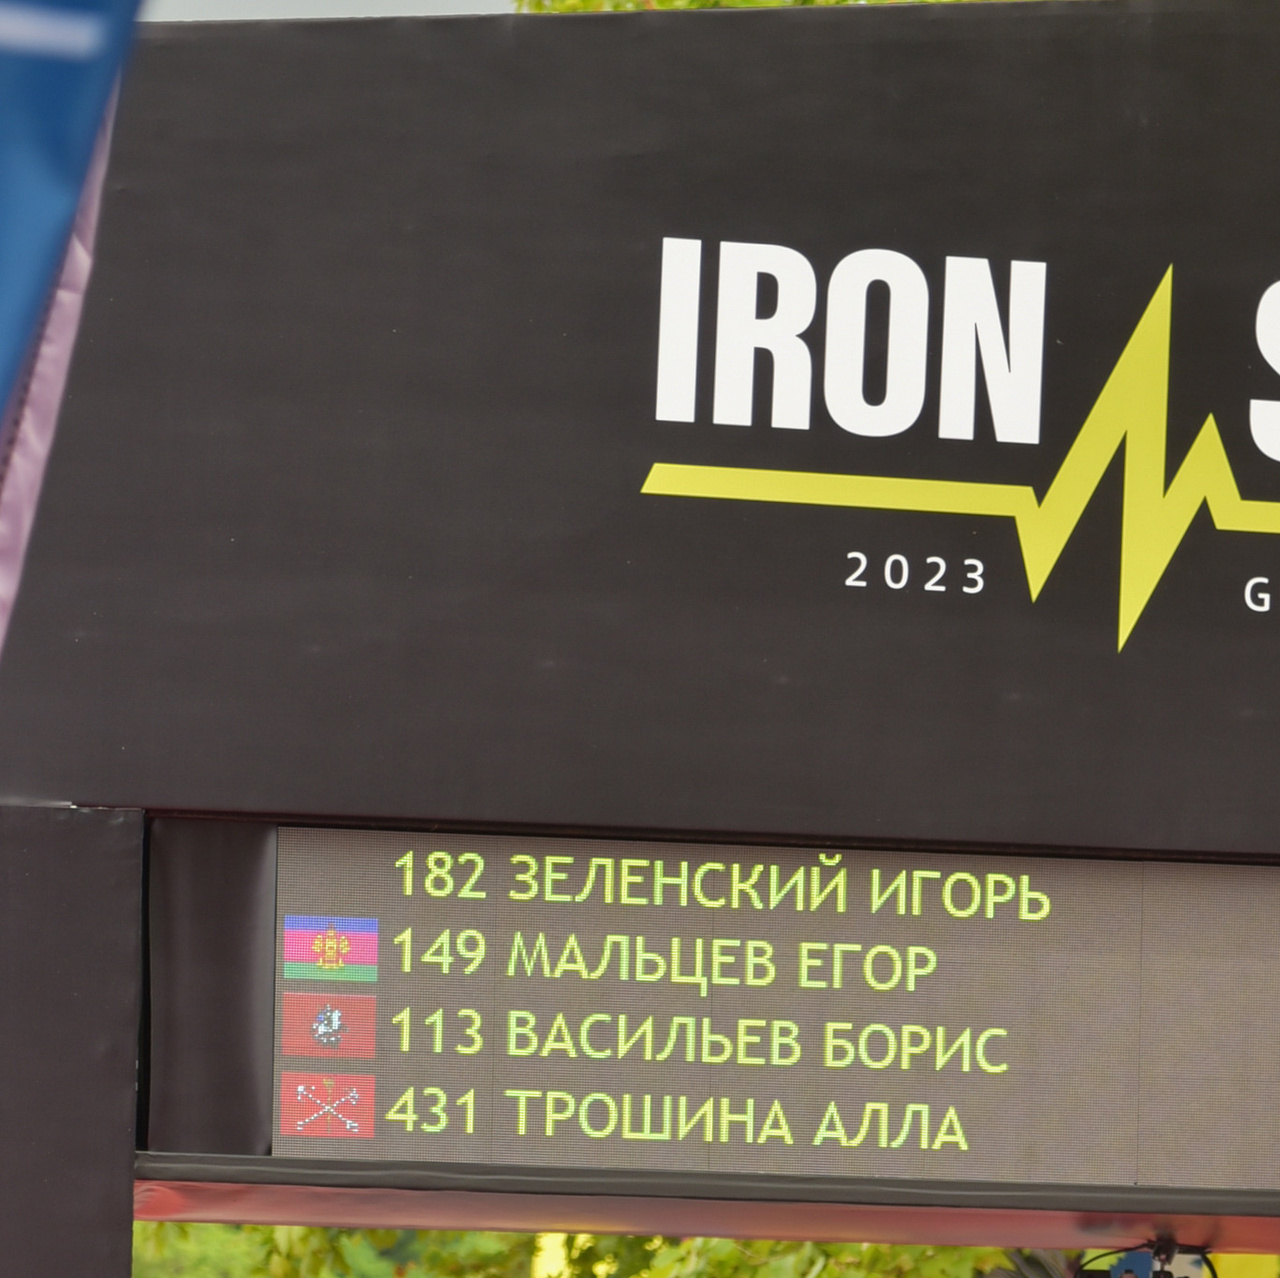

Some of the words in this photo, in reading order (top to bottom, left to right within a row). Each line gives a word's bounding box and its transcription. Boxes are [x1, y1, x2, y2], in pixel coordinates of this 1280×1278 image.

[655, 236, 1047, 445] IRON
[845, 551, 984, 594] 2023
[395, 851, 487, 898] 182
[508, 854, 847, 912] ЗЕЛЕНСКИЙ
[871, 869, 1052, 920] ИГОРЬ
[394, 928, 487, 974] 149
[506, 931, 776, 997] МАЛЬЦЕВ
[798, 942, 938, 992] ЕГОР
[392, 1008, 484, 1055] 113
[507, 1010, 802, 1067] ВАСИЛЬЕВ
[823, 1022, 1010, 1075] БОРИС
[385, 1086, 476, 1134] 431
[505, 1089, 795, 1146] ТРОШИНА
[812, 1101, 970, 1151] АЛЛА
